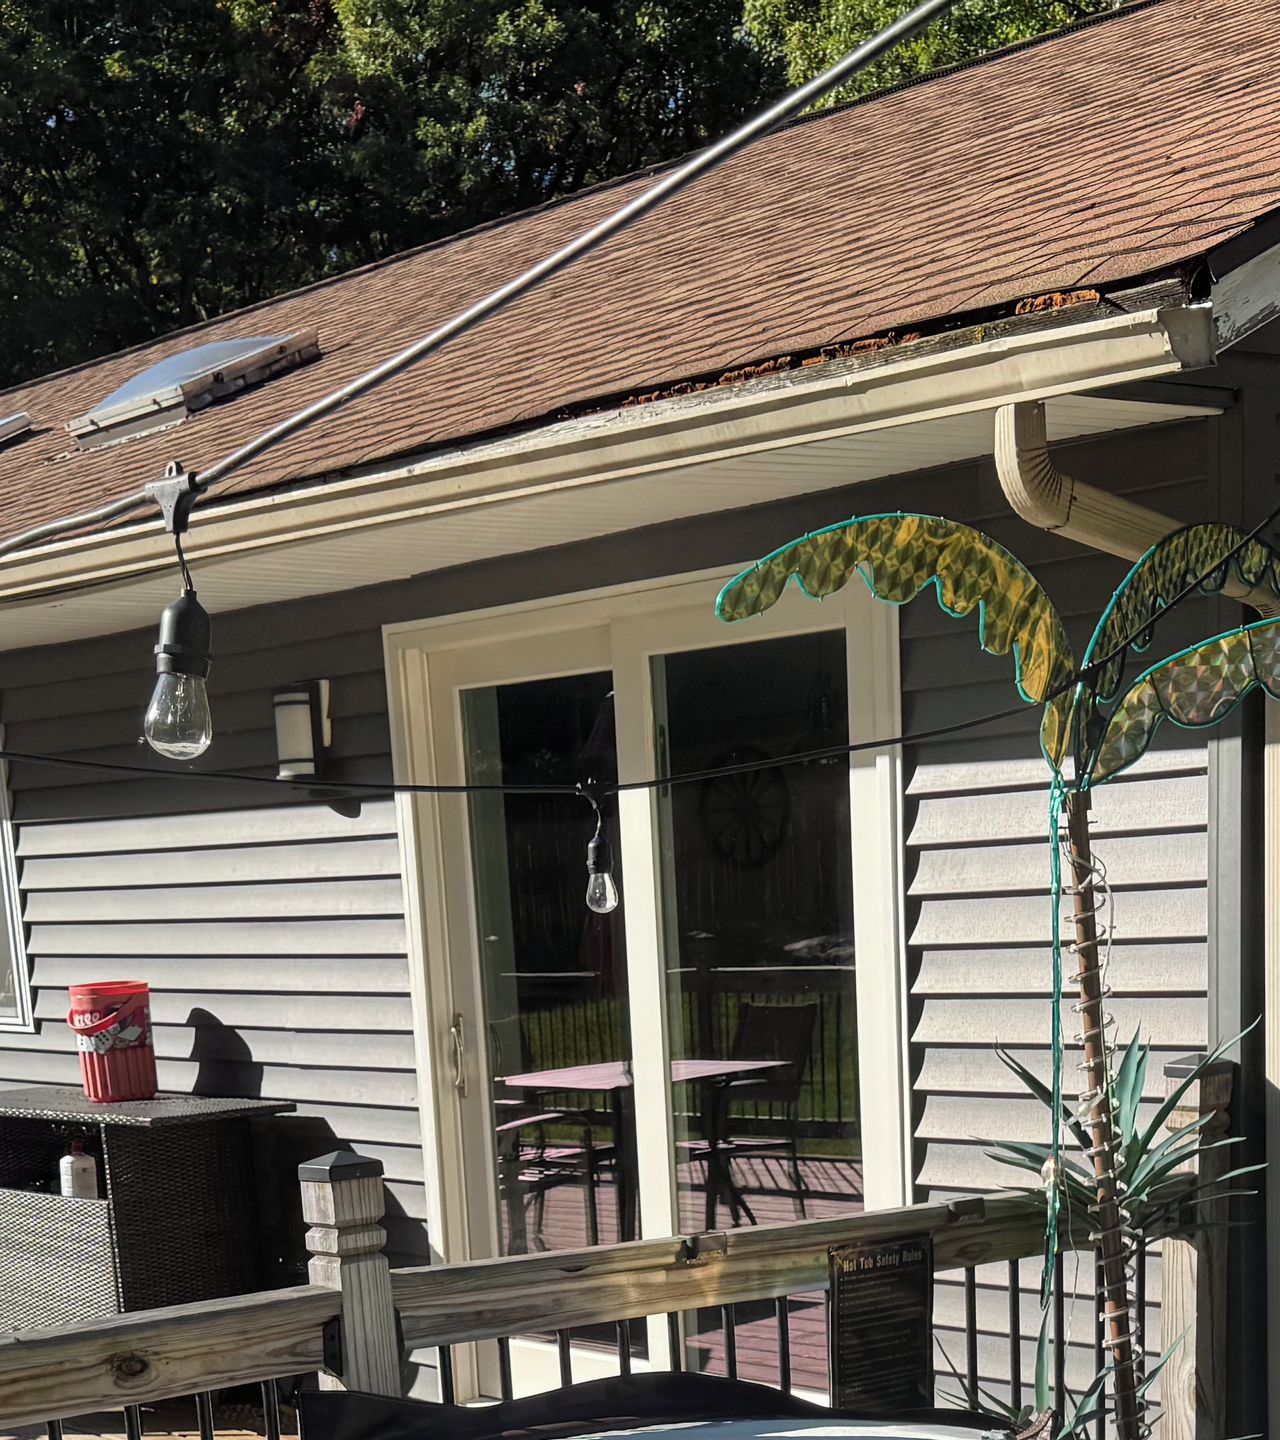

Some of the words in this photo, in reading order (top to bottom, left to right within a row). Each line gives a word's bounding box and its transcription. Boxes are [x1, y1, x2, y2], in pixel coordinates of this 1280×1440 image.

[843, 1259, 857, 1273] Hot
[860, 1256, 874, 1270] Tub
[877, 1252, 900, 1267] Safety
[903, 1248, 922, 1263] Rules
